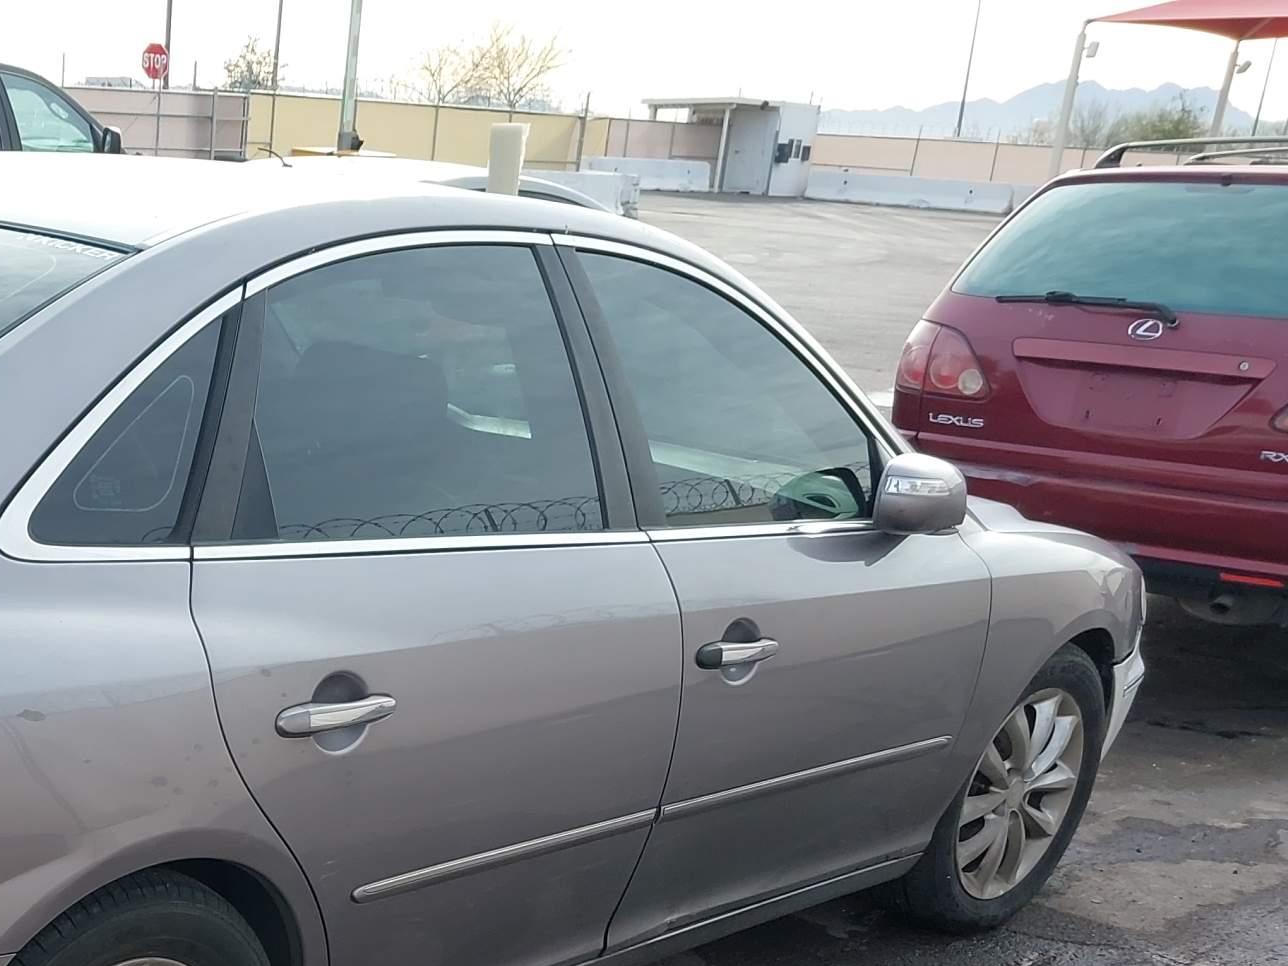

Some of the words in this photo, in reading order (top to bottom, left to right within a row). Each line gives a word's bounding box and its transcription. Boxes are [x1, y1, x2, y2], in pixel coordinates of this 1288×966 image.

[143, 52, 167, 69] STOP
[30, 232, 121, 260] KICKER
[929, 412, 984, 428] LEXUS
